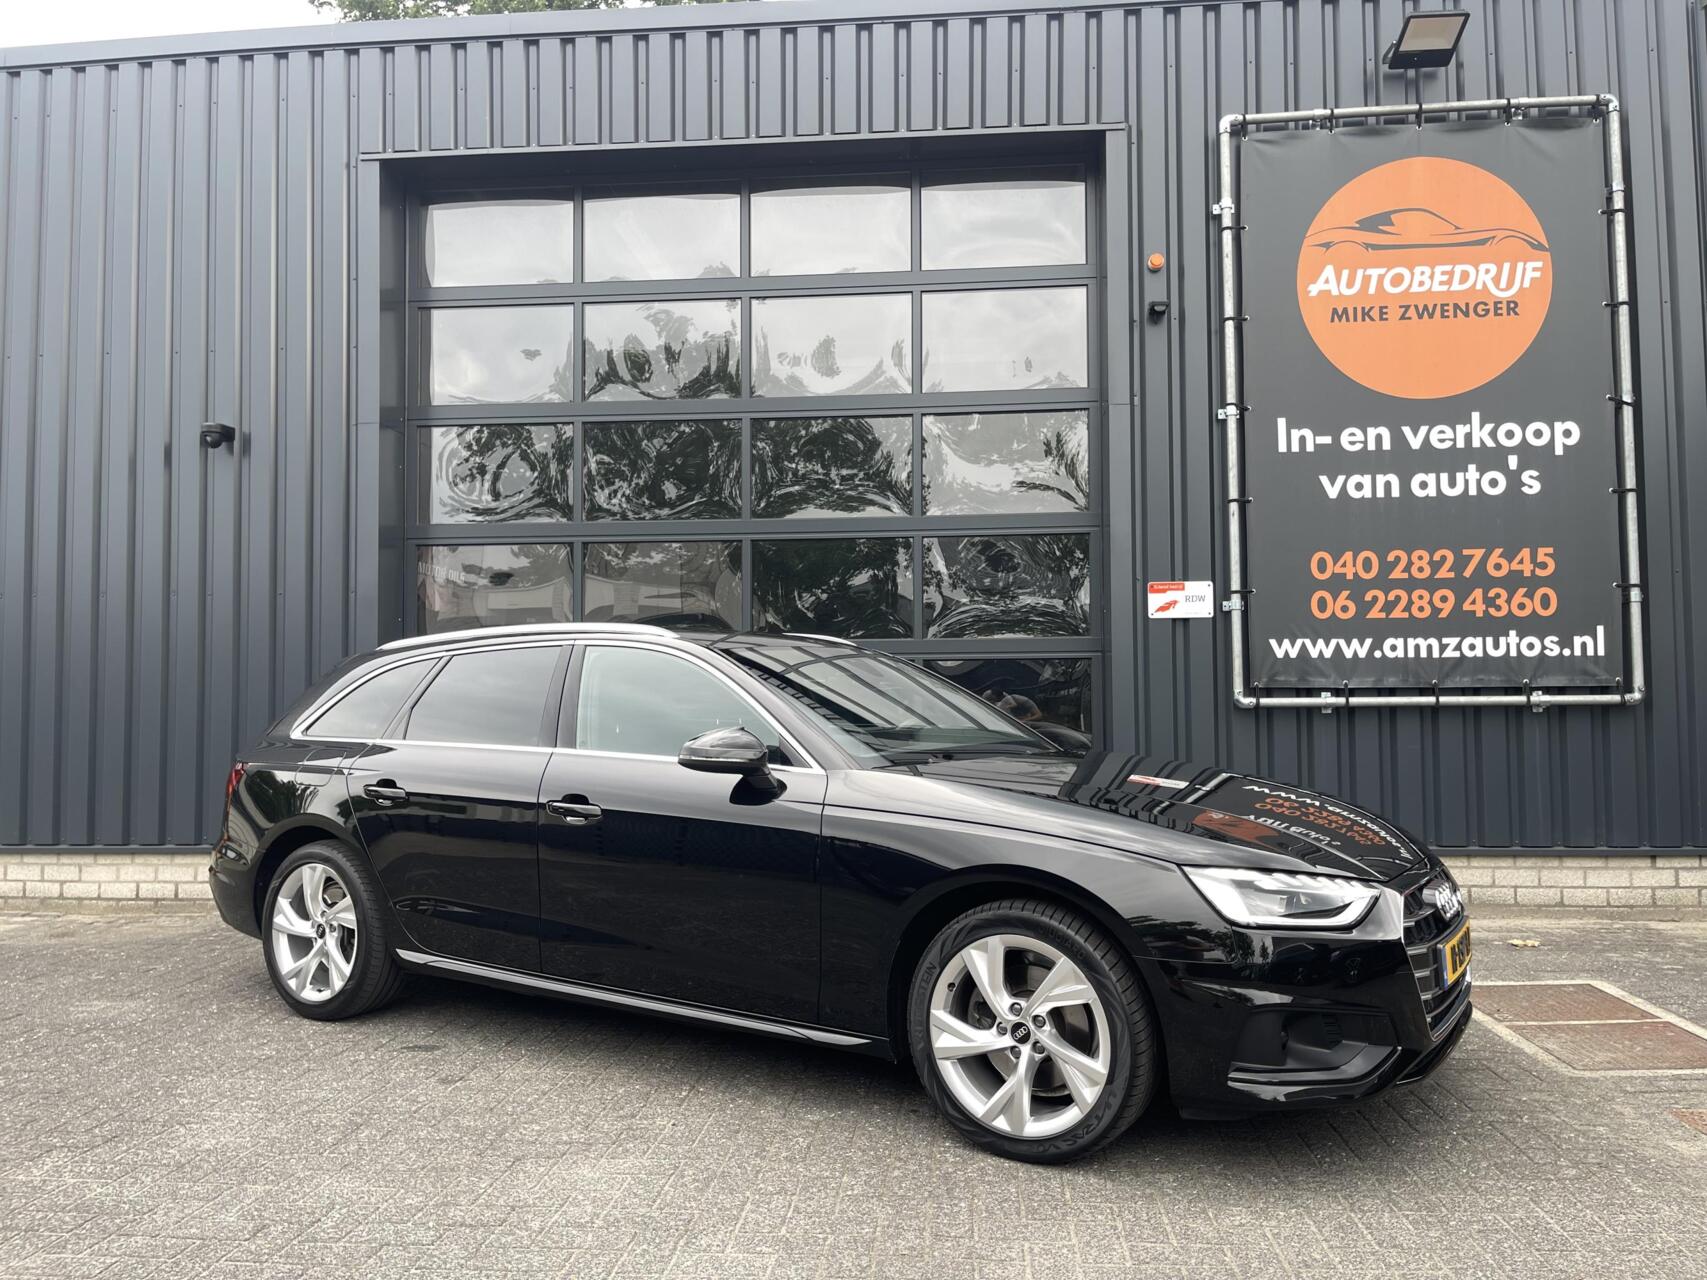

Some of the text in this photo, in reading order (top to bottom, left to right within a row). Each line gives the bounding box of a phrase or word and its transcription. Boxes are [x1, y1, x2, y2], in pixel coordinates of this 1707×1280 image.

[1307, 261, 1544, 298] AUTOBEDRIJF
[1330, 301, 1520, 323] MIKE ZWENGER
[1277, 411, 1581, 455] In- en verkoop
[1319, 455, 1542, 500] van auto's
[1310, 547, 1556, 580] 040 282 7645
[1185, 594, 1206, 603] RDW
[1310, 587, 1558, 620] 06 2289 4360
[1269, 625, 1605, 659] www.amzautos.nl
